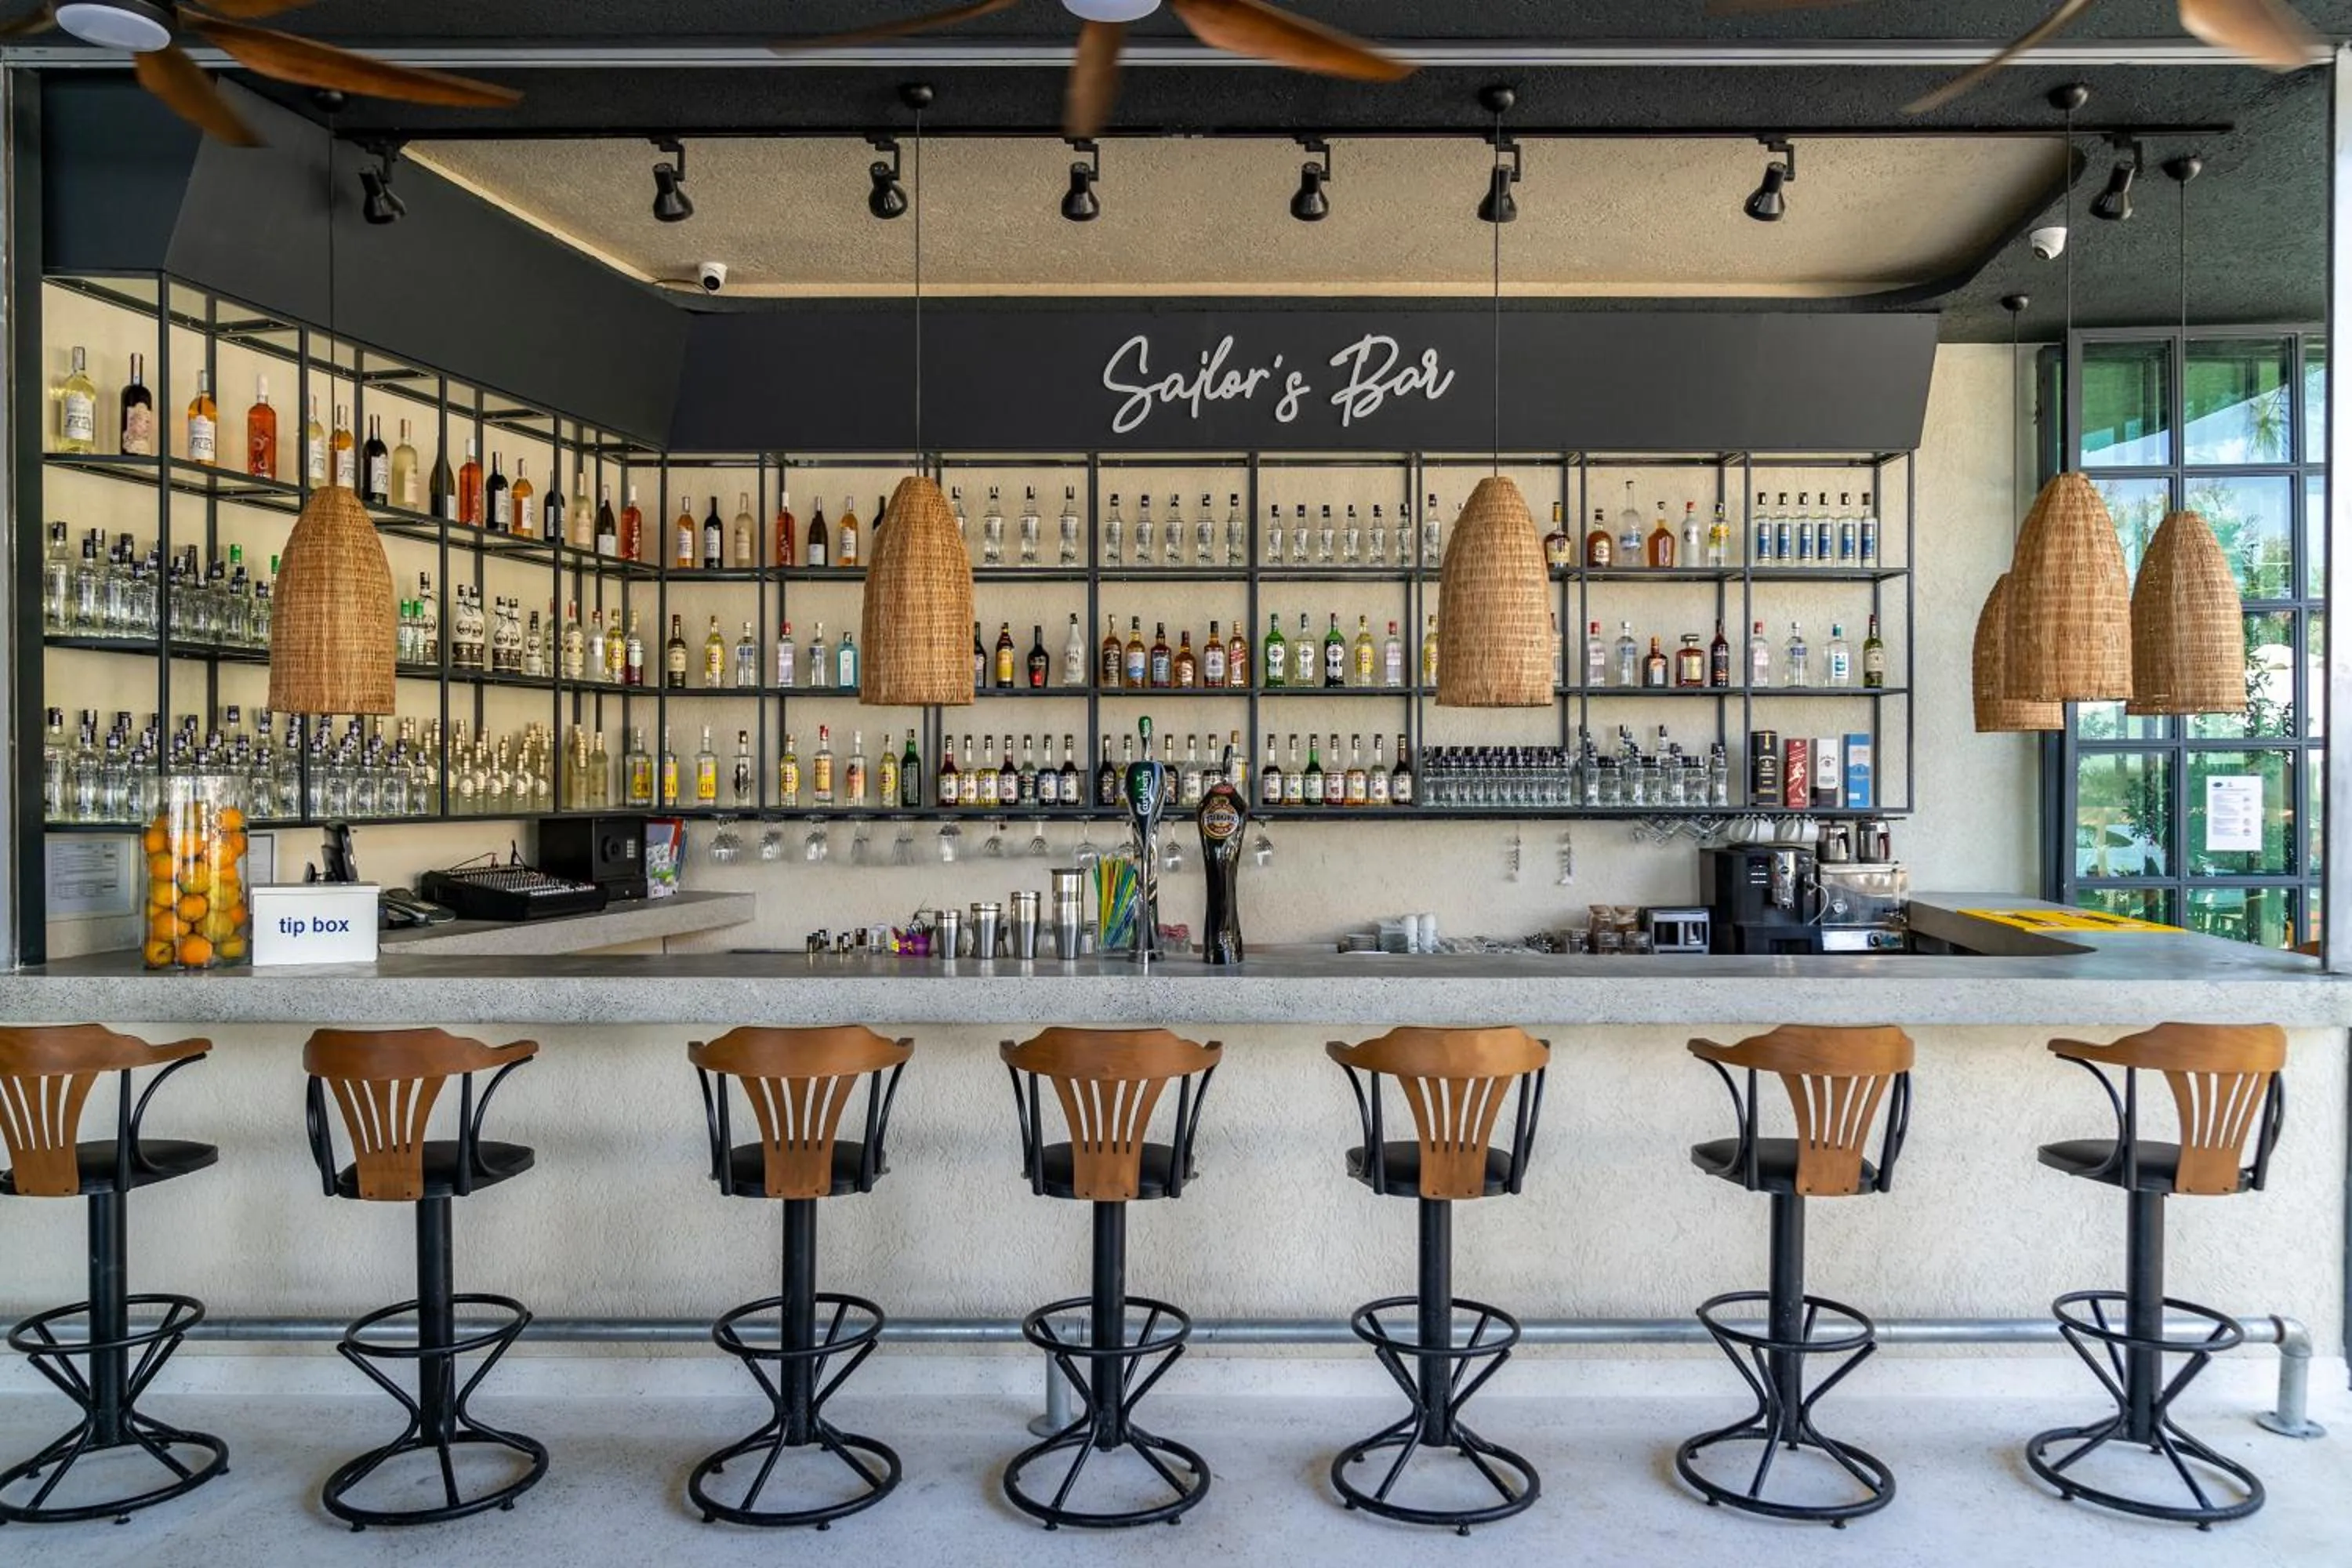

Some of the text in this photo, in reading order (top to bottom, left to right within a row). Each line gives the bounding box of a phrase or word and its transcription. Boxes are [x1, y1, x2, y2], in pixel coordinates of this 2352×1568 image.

[1103, 334, 1454, 433] Sailor's Bar
[279, 916, 350, 938] tip box
